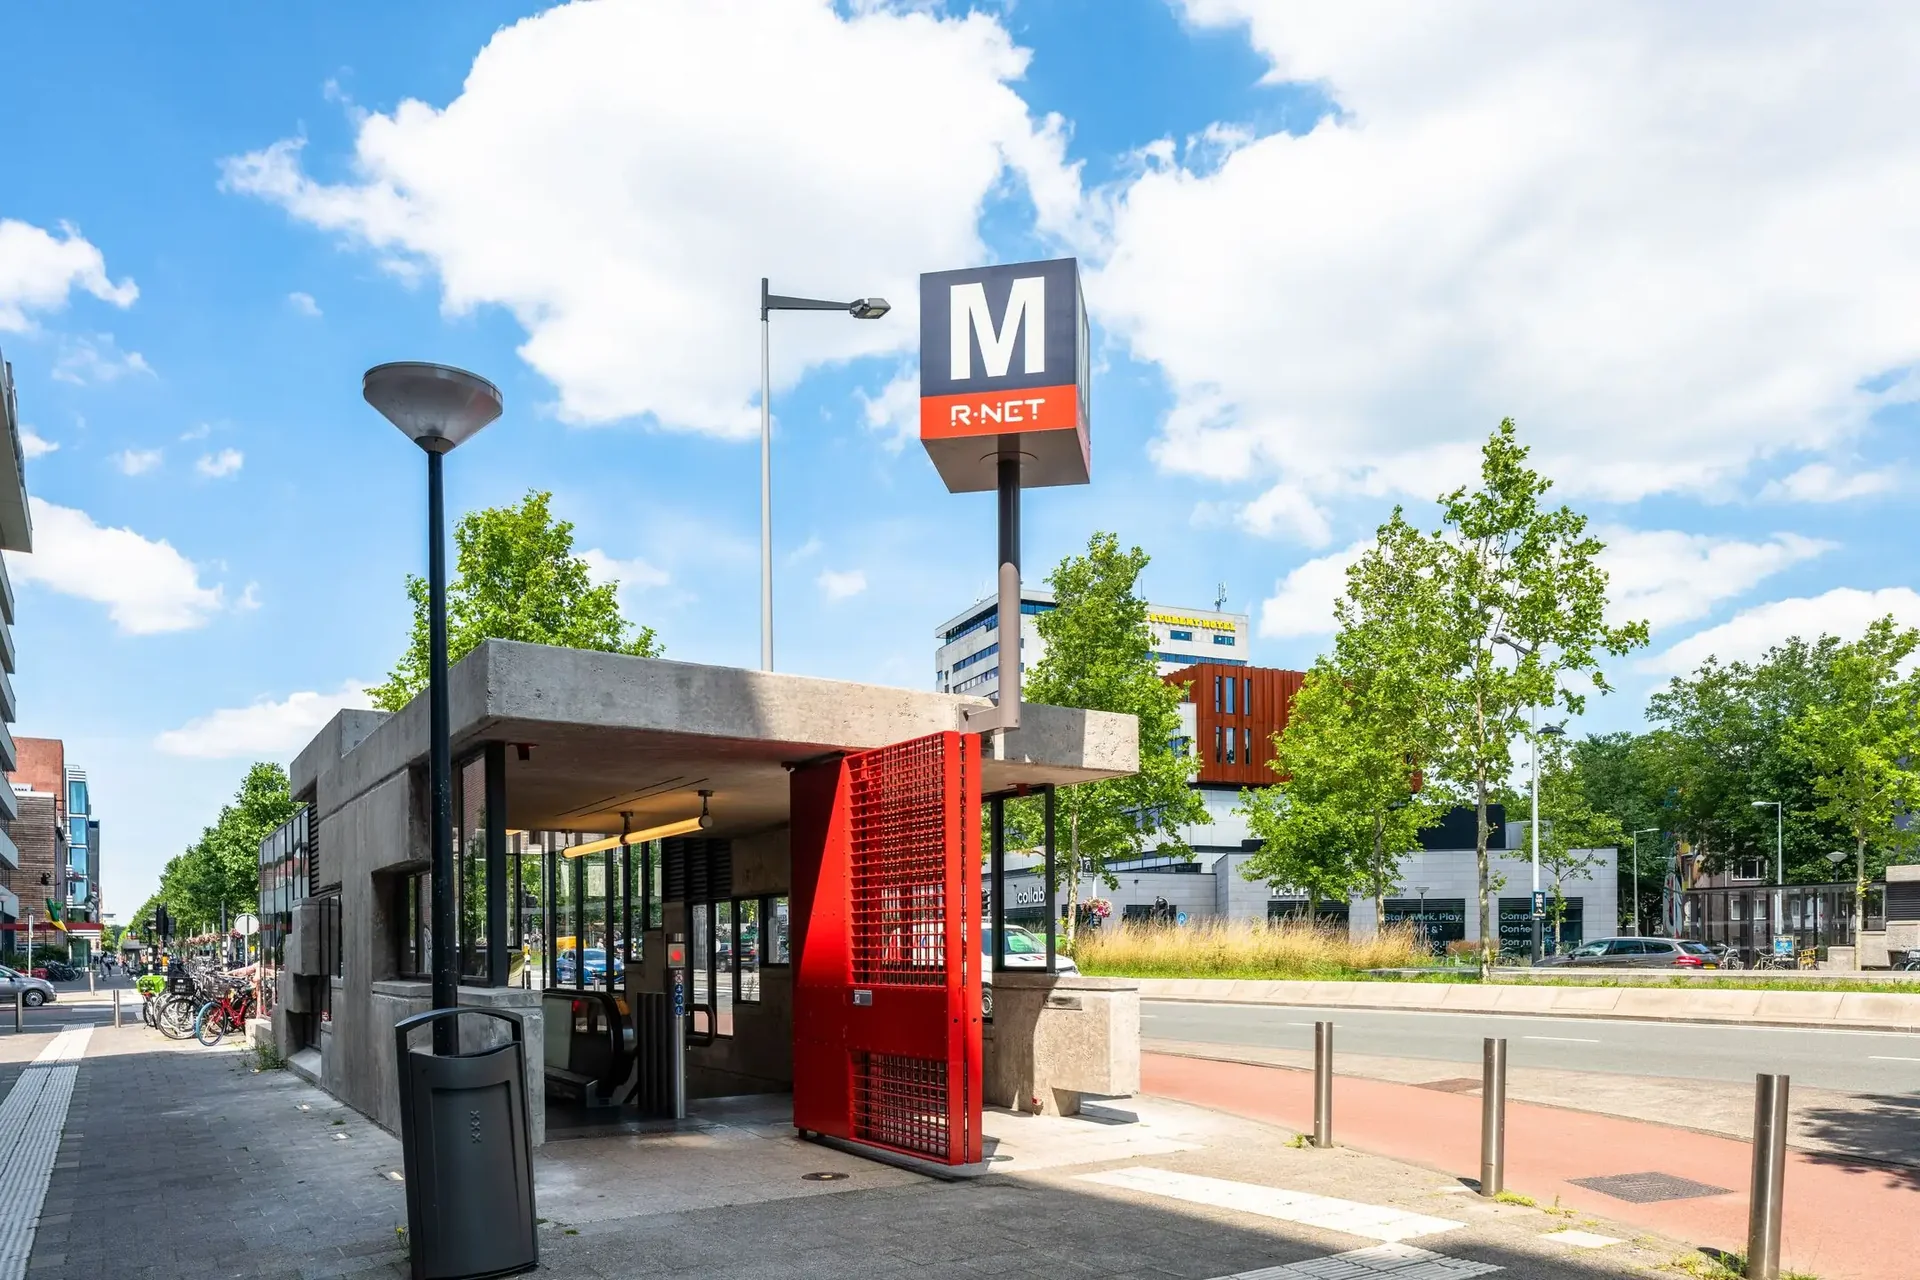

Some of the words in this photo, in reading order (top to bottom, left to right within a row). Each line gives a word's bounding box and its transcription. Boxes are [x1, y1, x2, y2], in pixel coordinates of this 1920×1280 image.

[950, 276, 1045, 380] M
[1150, 613, 1199, 627] STUDENT
[1201, 620, 1235, 632] HOTEL
[1439, 913, 1462, 922] Play.
